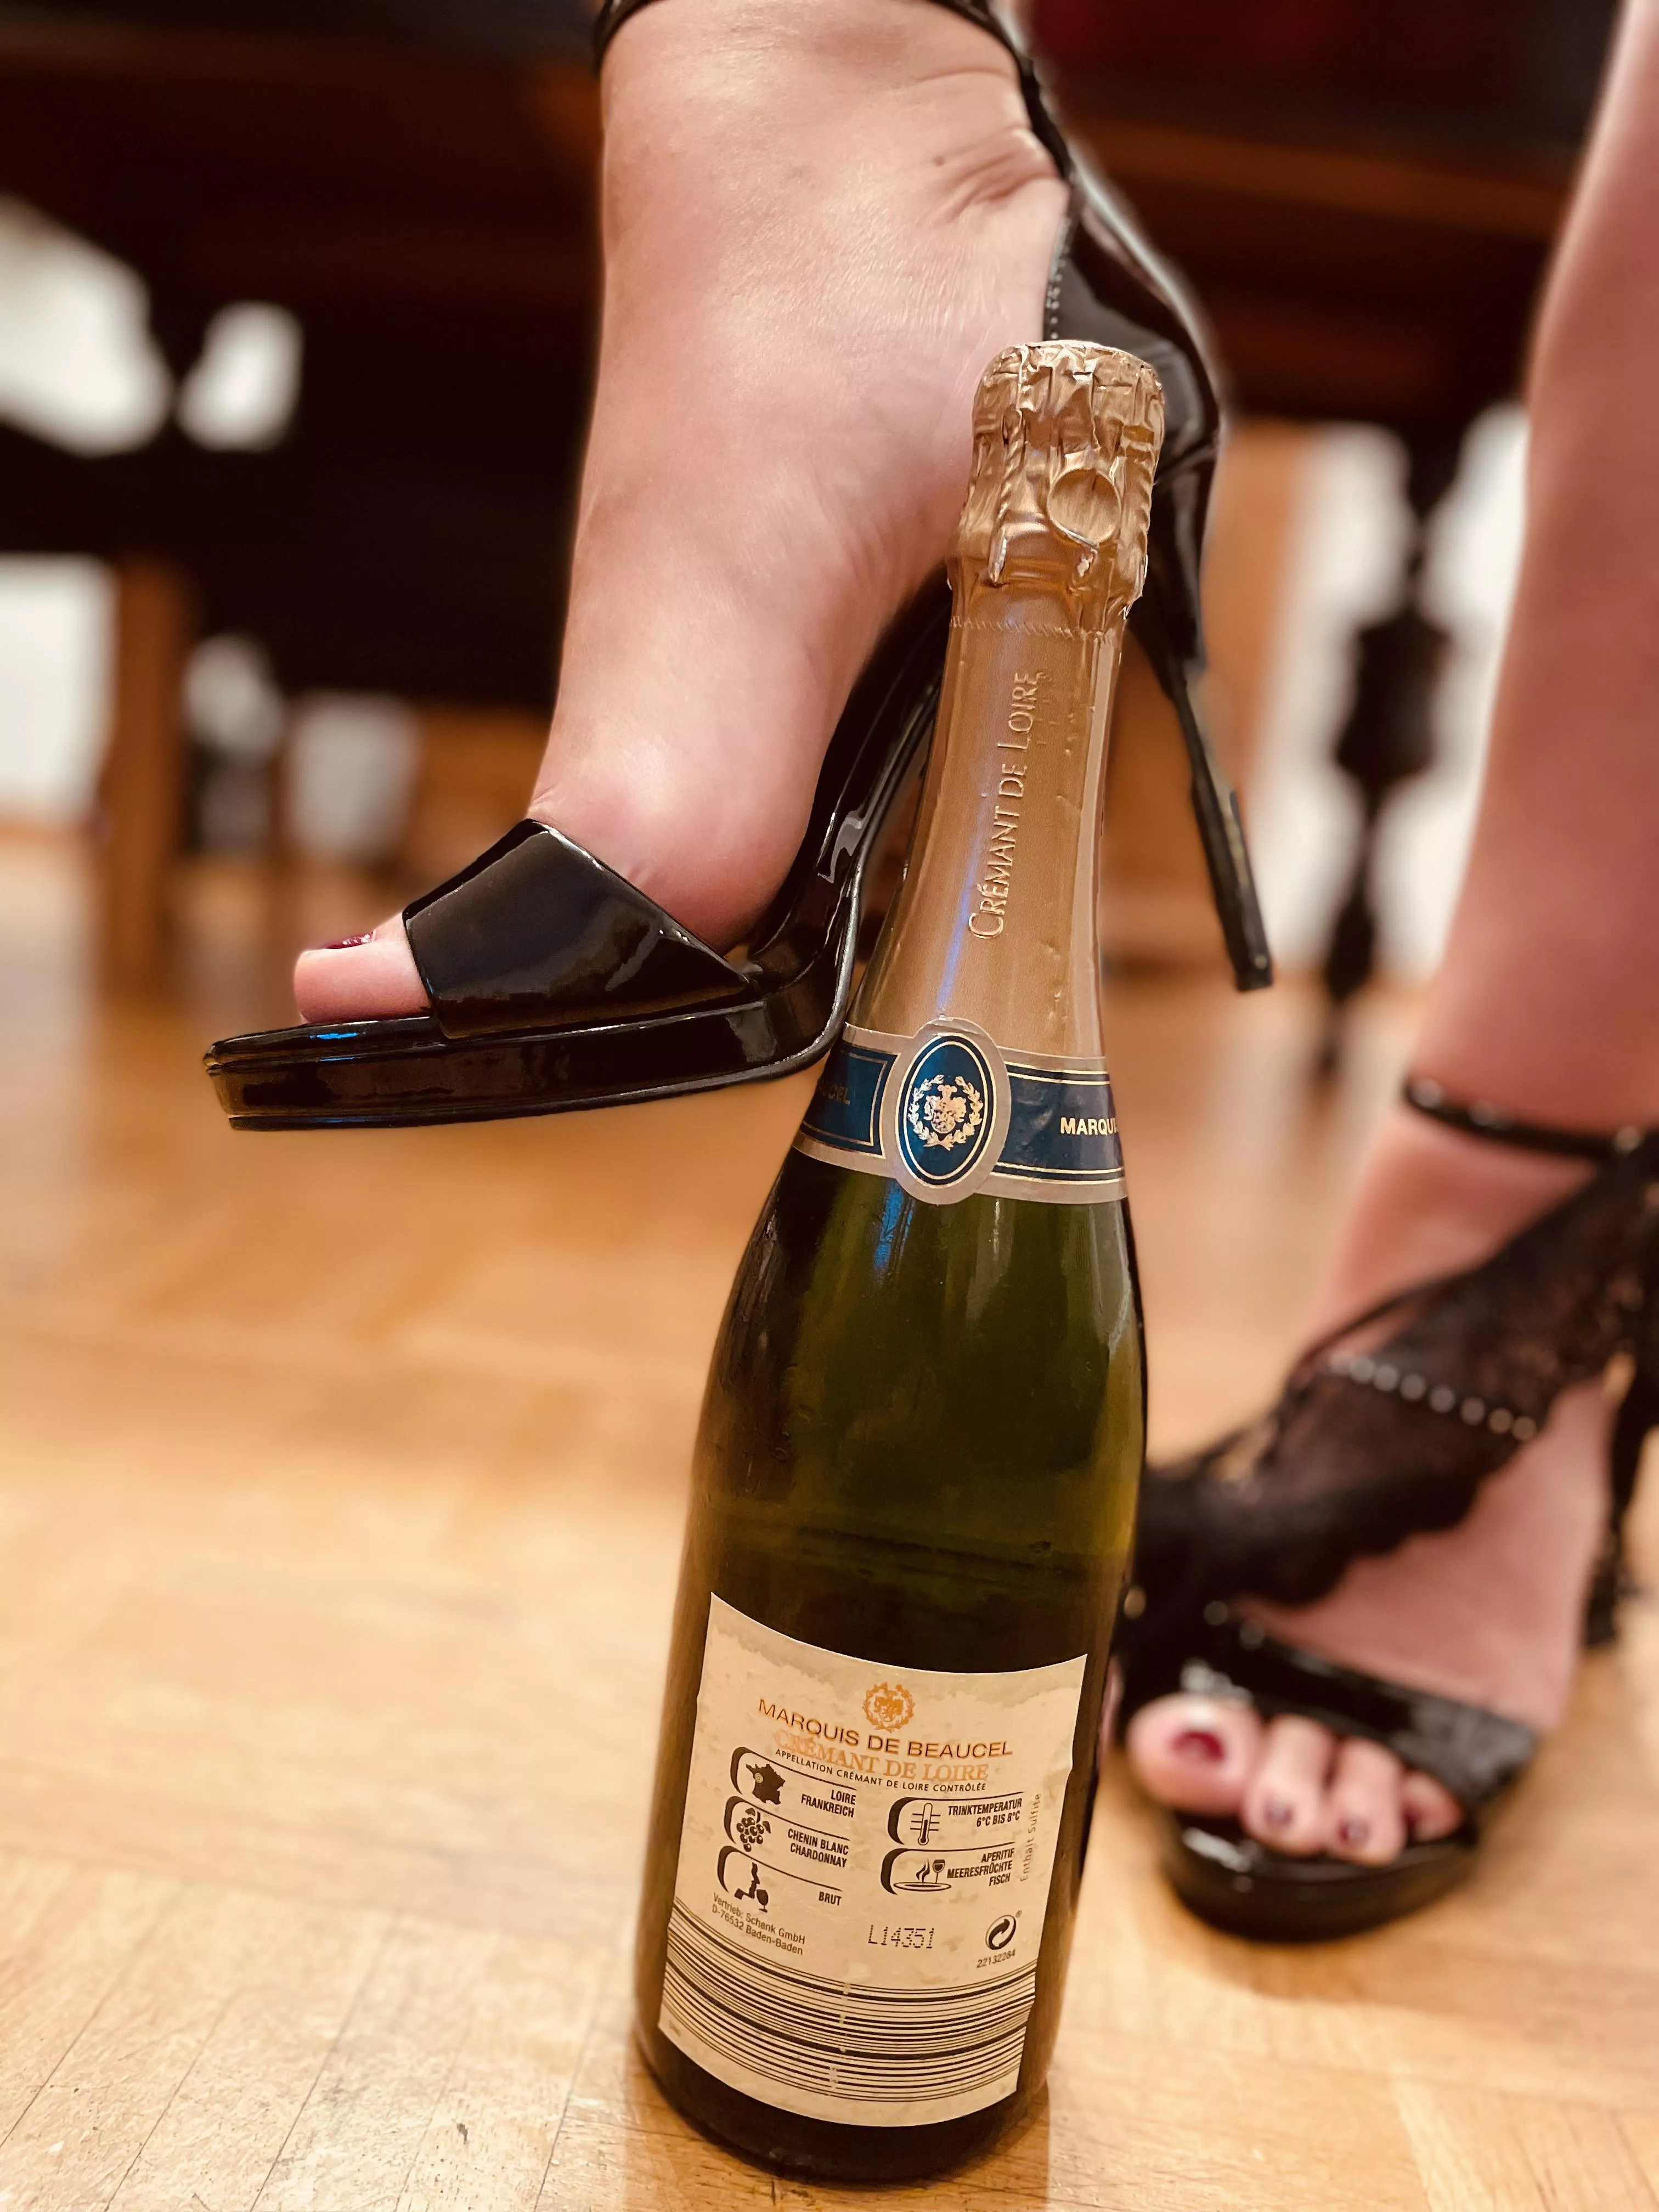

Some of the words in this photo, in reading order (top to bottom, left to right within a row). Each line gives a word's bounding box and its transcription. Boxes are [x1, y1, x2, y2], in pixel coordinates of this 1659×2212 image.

[998, 763, 1028, 799] DE
[1060, 1116, 1118, 1136] MARQUI
[758, 1699, 860, 1747] MARQUIS
[867, 1734, 900, 1755] DE
[907, 1741, 1014, 1760] BEAUCEL
[774, 1729, 880, 1774] CRÉMANT
[883, 1759, 917, 1780] DE
[921, 1762, 989, 1783] LOIRE
[775, 1748, 833, 1775] APPELLATION
[837, 1769, 883, 1786] CRÉMANT
[886, 1780, 899, 1788] DE
[902, 1782, 929, 1792] LOIRE
[933, 1782, 986, 1792] CONTRÔLÉE
[801, 1793, 855, 1818] FRANKREICH
[831, 1790, 857, 1805] LOIRE
[947, 1798, 1023, 1816] TRINKTEMPERATUR
[992, 1813, 1006, 1825] BIS
[1028, 1793, 1041, 1833] Sulfite
[787, 1828, 818, 1847] CHENIN
[820, 1839, 849, 1855] BLANC
[790, 1843, 848, 1867] CHARDONNAY
[981, 1847, 1015, 1863] APERITIF
[989, 1872, 1011, 1887] FISCH
[818, 1891, 842, 1906] BRUT
[714, 1892, 743, 1918] Vertrieb:
[746, 1912, 776, 1934] Schenk
[778, 1927, 805, 1944] GmbH
[746, 1925, 803, 1955] Baden-Baden
[868, 1925, 934, 1949] L14351
